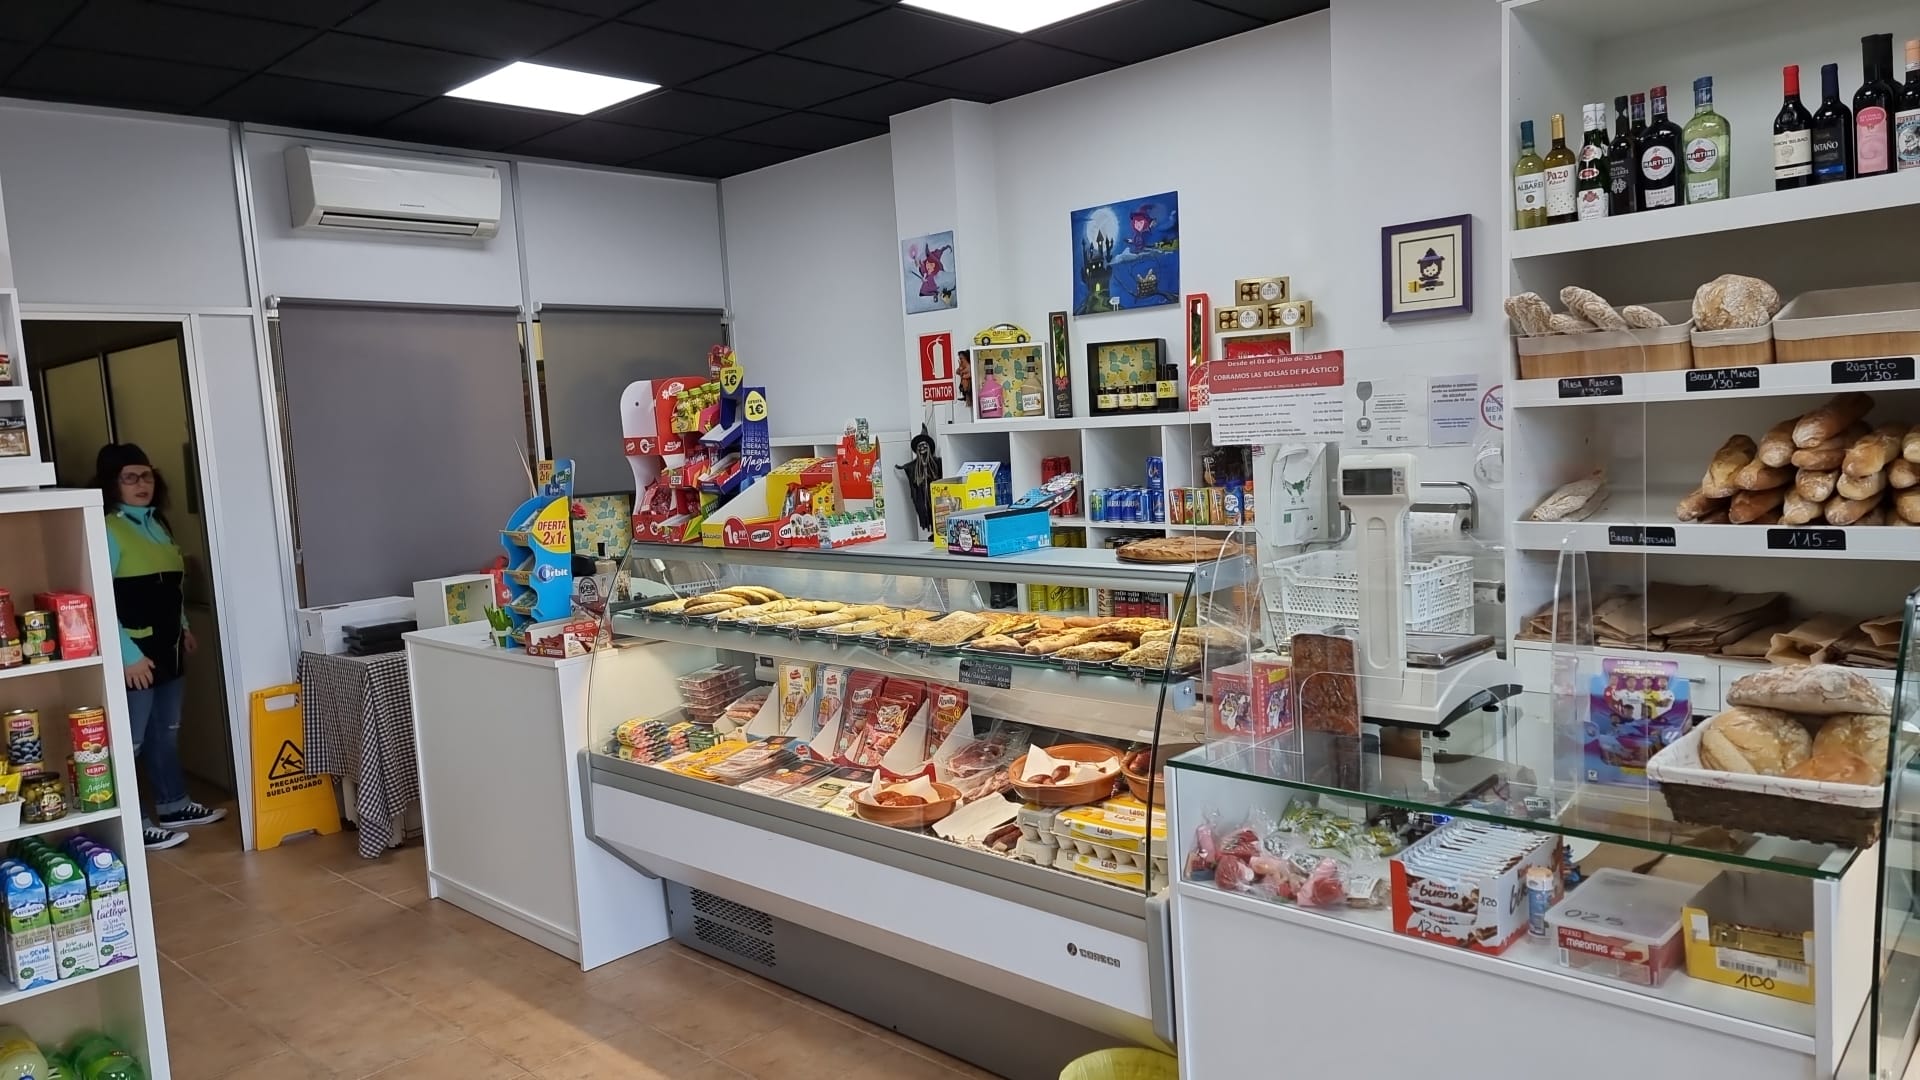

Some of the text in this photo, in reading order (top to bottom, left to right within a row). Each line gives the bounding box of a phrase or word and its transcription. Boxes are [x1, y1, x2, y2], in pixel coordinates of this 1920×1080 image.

[1686, 149, 1716, 161] MARTINI
[1643, 157, 1672, 168] MARTINI
[1517, 181, 1544, 192] ALBAREI
[1277, 356, 1292, 364] julio
[1213, 372, 1250, 381] COBRAMOS
[1264, 369, 1288, 377] BOLSAS
[1290, 368, 1300, 376] DE
[1301, 366, 1339, 374] PLÁSTICO
[724, 374, 737, 386] 1€
[924, 386, 953, 399] EXTINTOR
[749, 404, 764, 416] 1€
[740, 456, 770, 473] Magia
[538, 520, 566, 532] OFERTA
[752, 530, 771, 540] conguitos
[266, 779, 322, 798] SUELO MOJADO
[1420, 885, 1458, 900] bueno
[1566, 938, 1608, 953] MAROMAS
